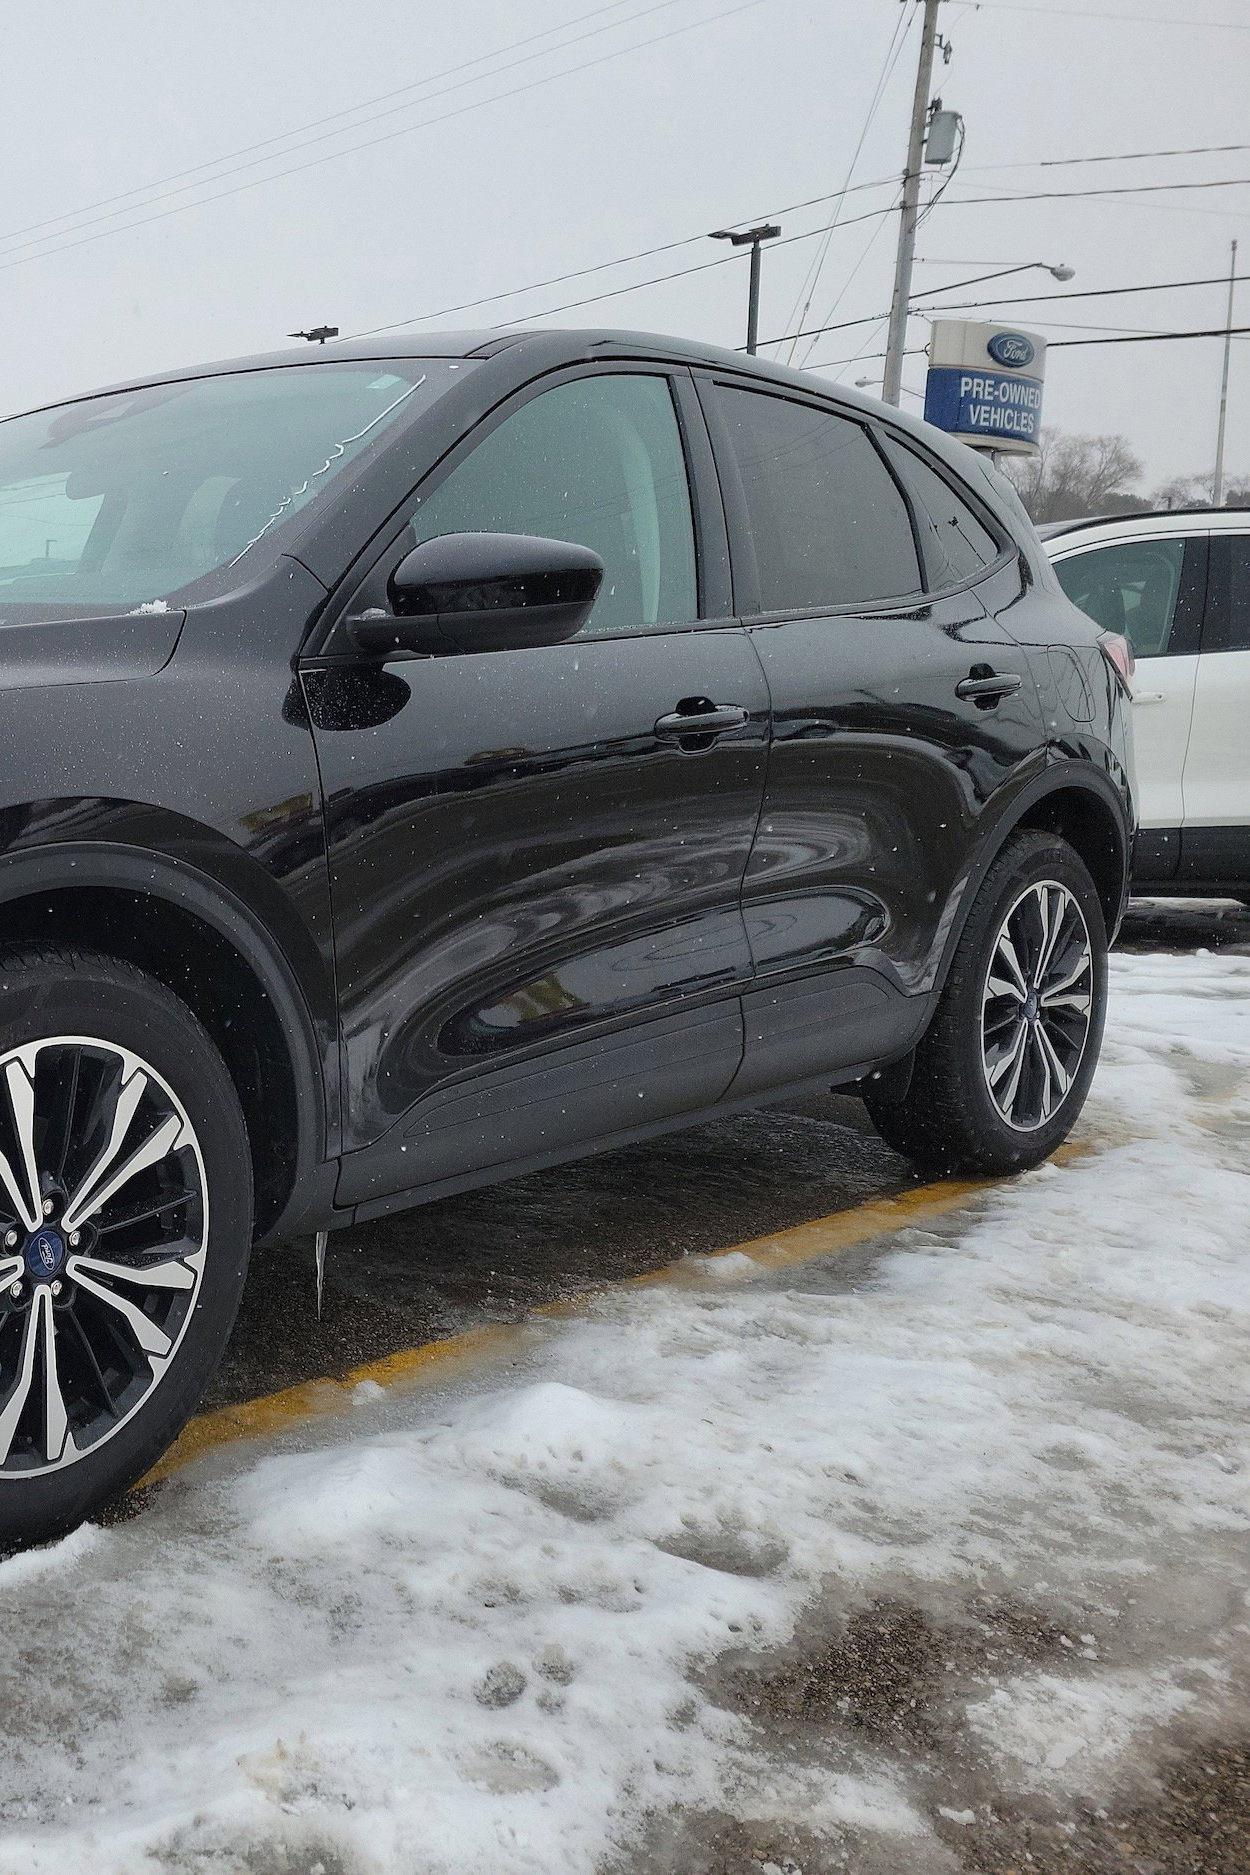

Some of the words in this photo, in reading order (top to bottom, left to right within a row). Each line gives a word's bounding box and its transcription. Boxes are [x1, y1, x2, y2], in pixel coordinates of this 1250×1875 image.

[1003, 340, 1029, 361] Ford
[960, 377, 1041, 409] PRE-OWNED
[969, 404, 1034, 433] VEHICLES
